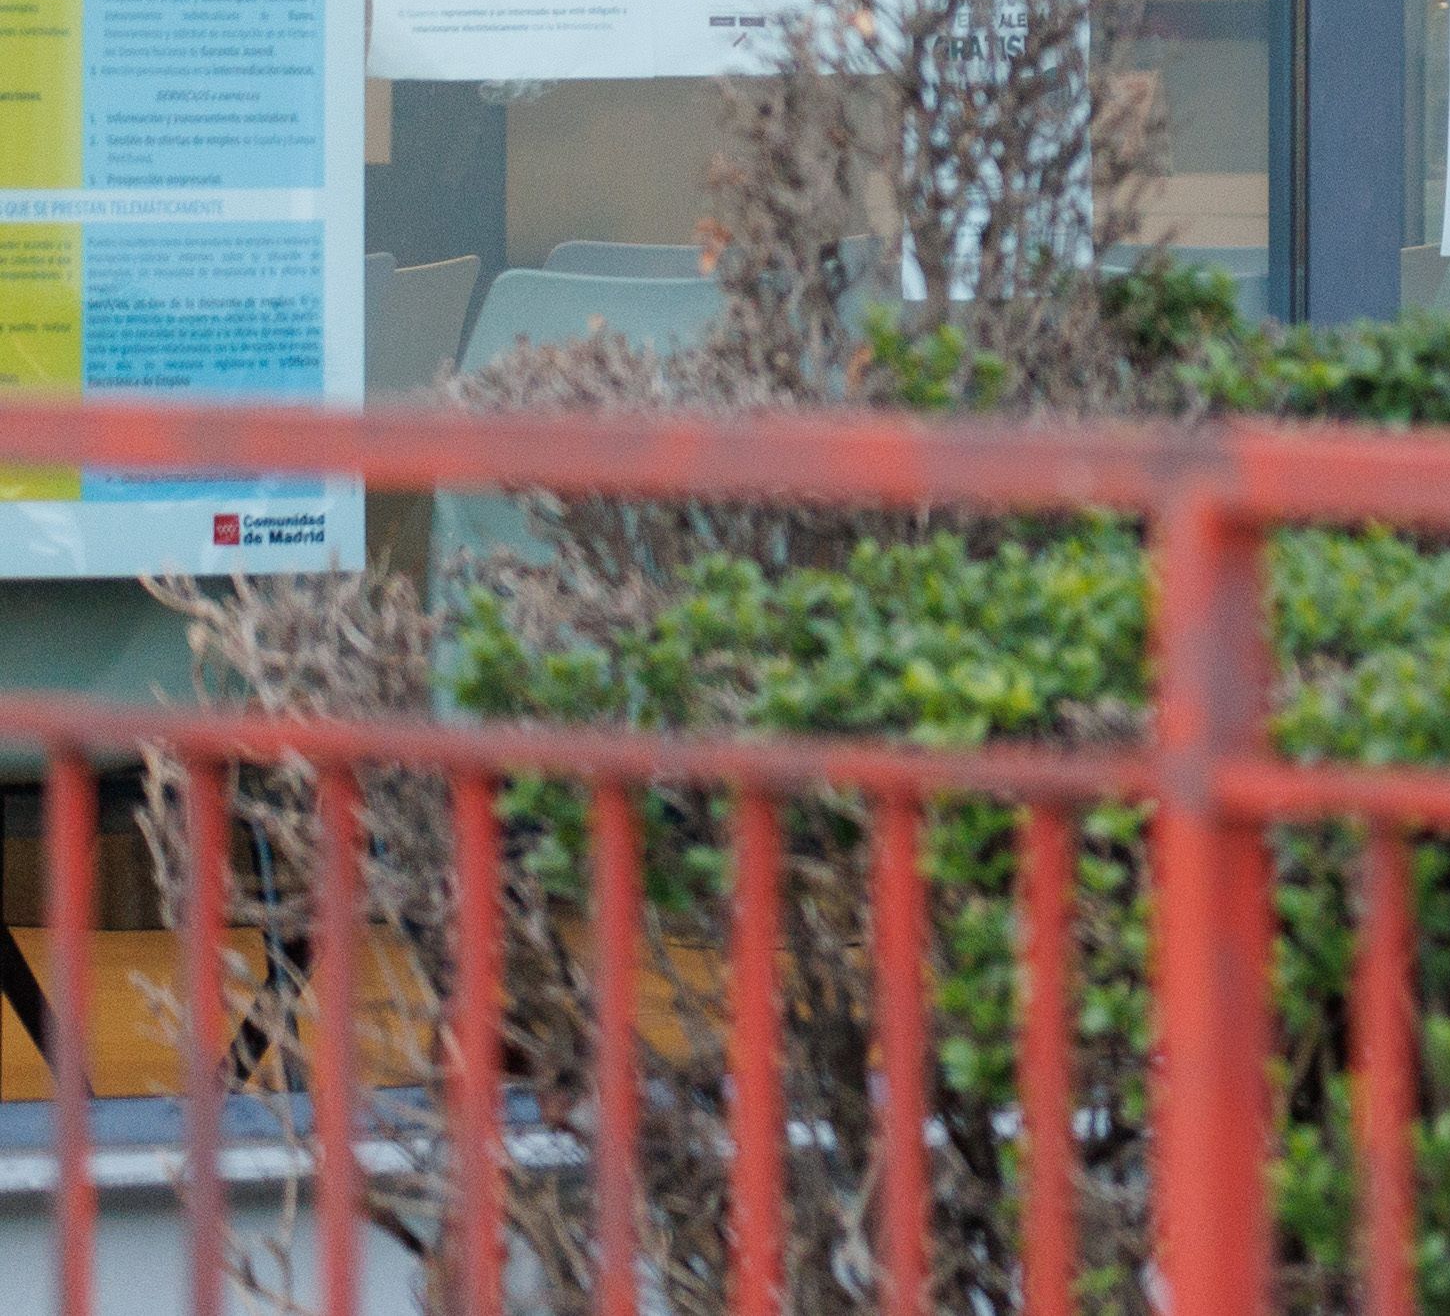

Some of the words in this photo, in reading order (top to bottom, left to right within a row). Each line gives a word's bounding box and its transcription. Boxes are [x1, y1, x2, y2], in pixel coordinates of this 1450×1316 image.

[244, 514, 325, 527] Comunidad
[244, 531, 262, 544] de
[270, 530, 325, 544] Madrid
